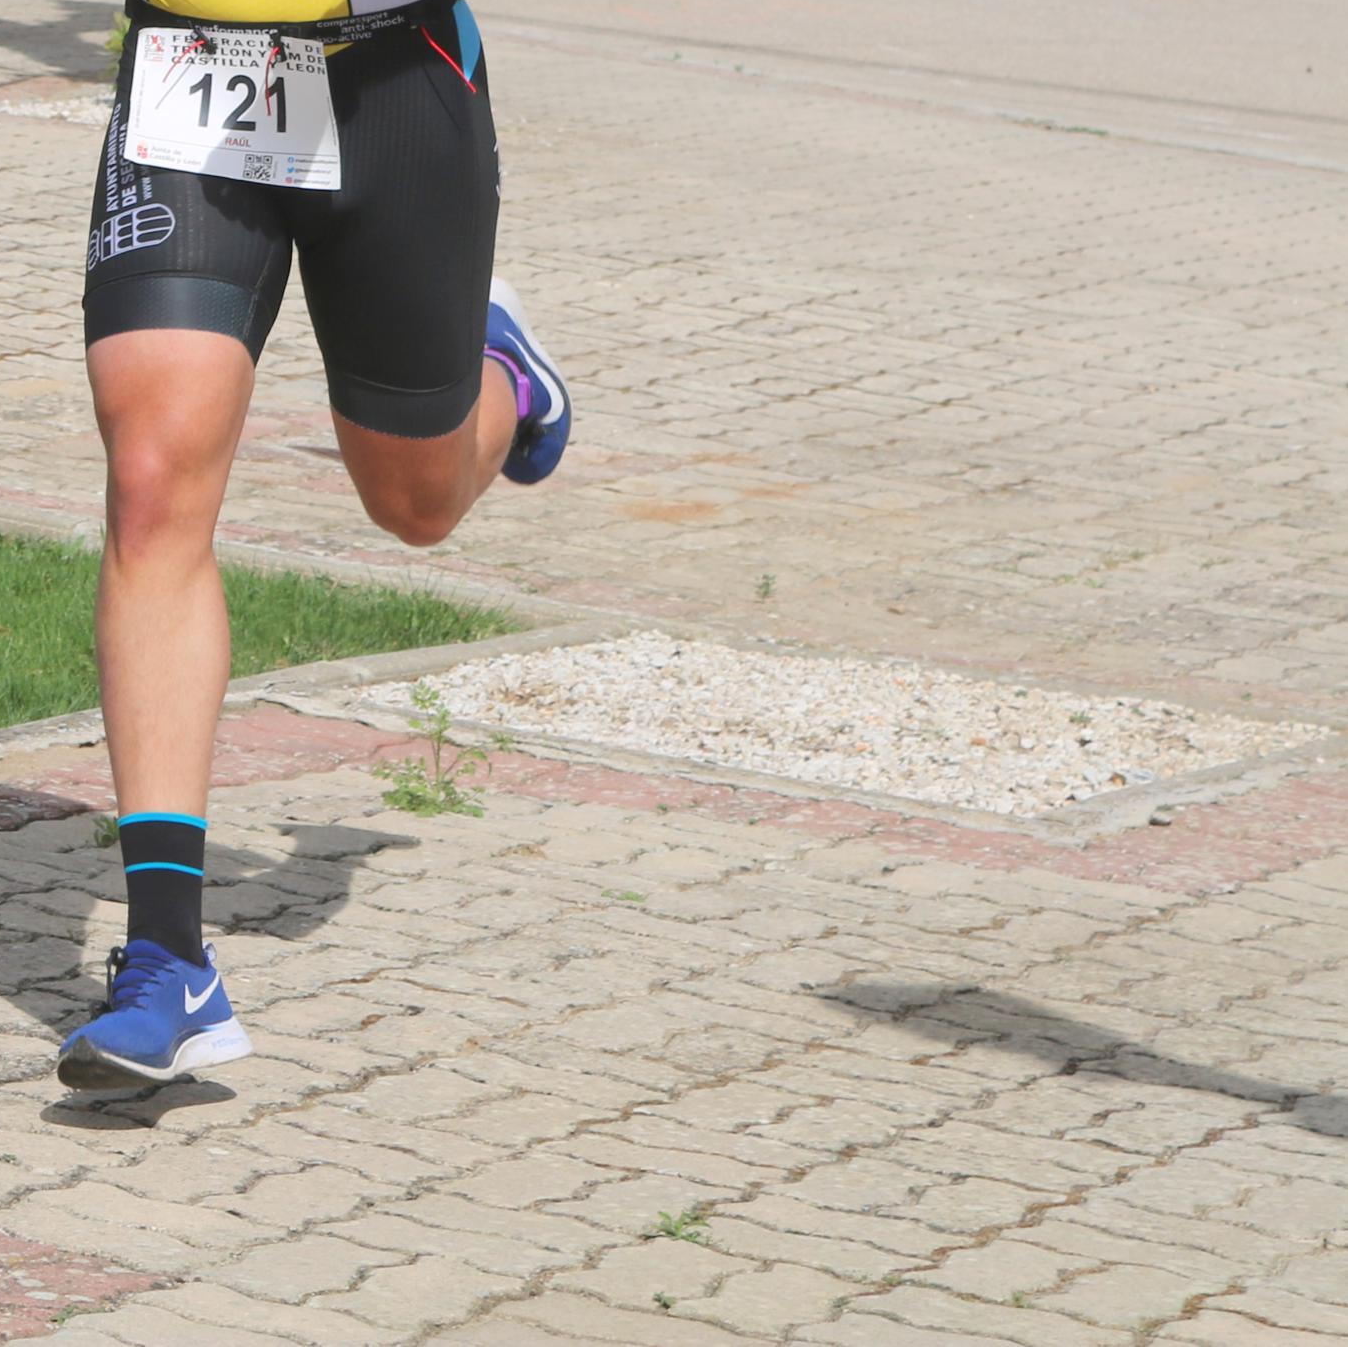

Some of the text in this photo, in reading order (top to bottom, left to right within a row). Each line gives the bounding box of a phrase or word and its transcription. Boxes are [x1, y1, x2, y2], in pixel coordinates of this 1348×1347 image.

[316, 12, 389, 28] compressport
[341, 14, 405, 34] anti-shock
[259, 49, 268, 58] Y
[307, 54, 324, 65] DE
[305, 44, 321, 54] DE
[171, 55, 260, 68] CASTILLA
[286, 62, 326, 76] LEON
[189, 73, 287, 133] 121
[224, 136, 252, 148] RAÚL
[106, 103, 122, 212] AYUNTAMIENTO
[121, 185, 138, 207] DE
